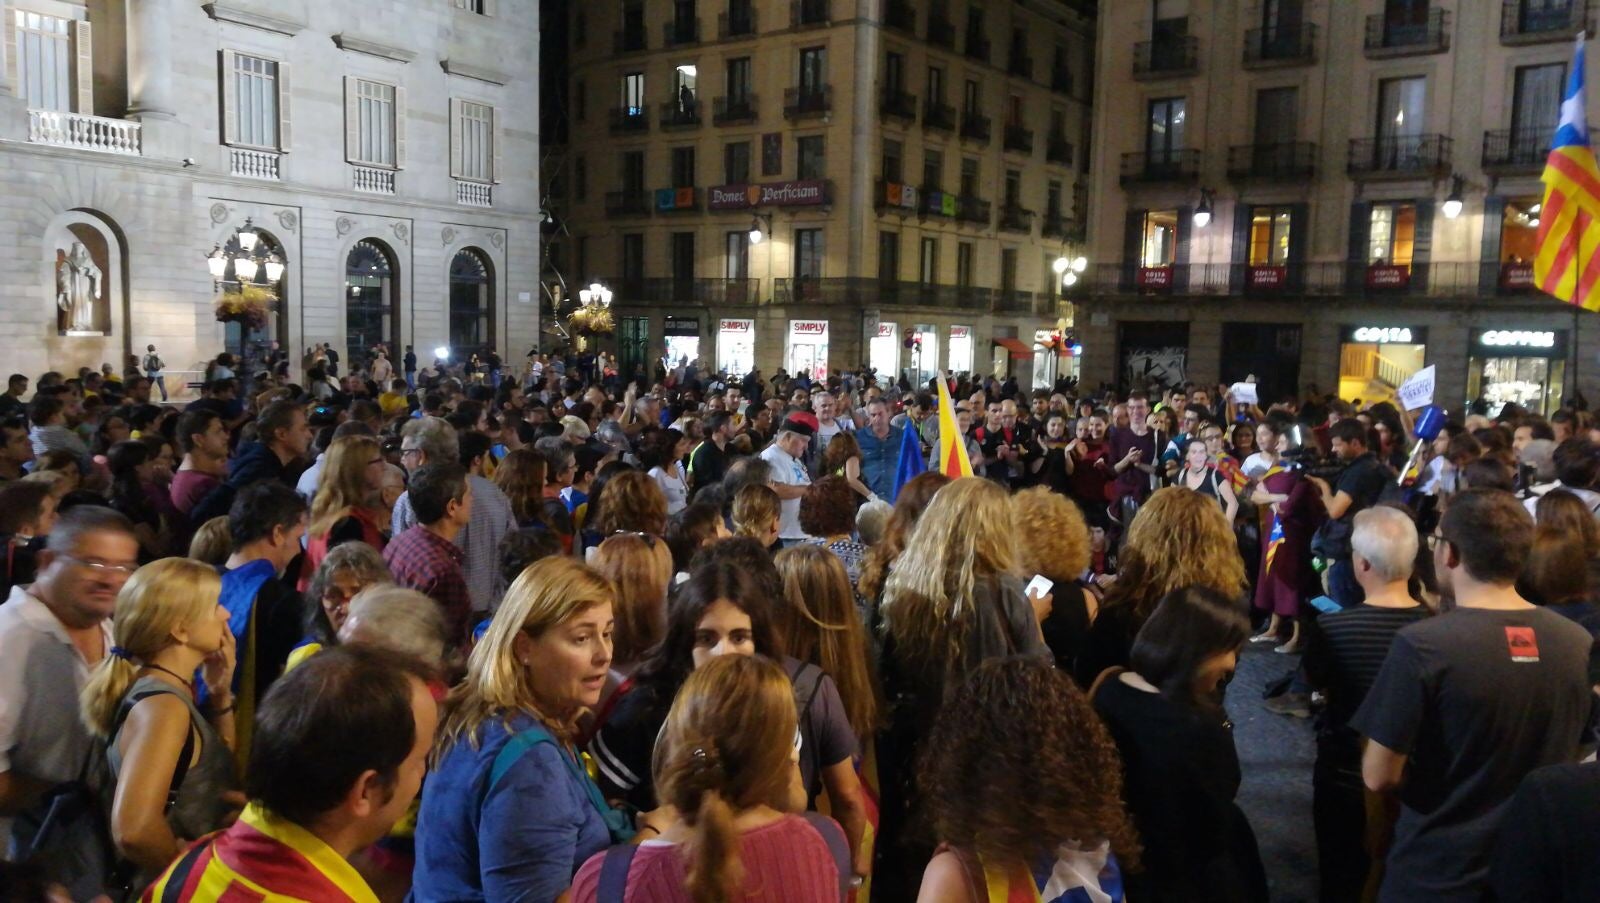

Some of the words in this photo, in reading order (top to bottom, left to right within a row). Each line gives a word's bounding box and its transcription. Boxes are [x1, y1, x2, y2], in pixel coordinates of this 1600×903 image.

[712, 189, 745, 203] Donec
[762, 183, 818, 203] Perficiam
[1353, 327, 1412, 343] COSTA
